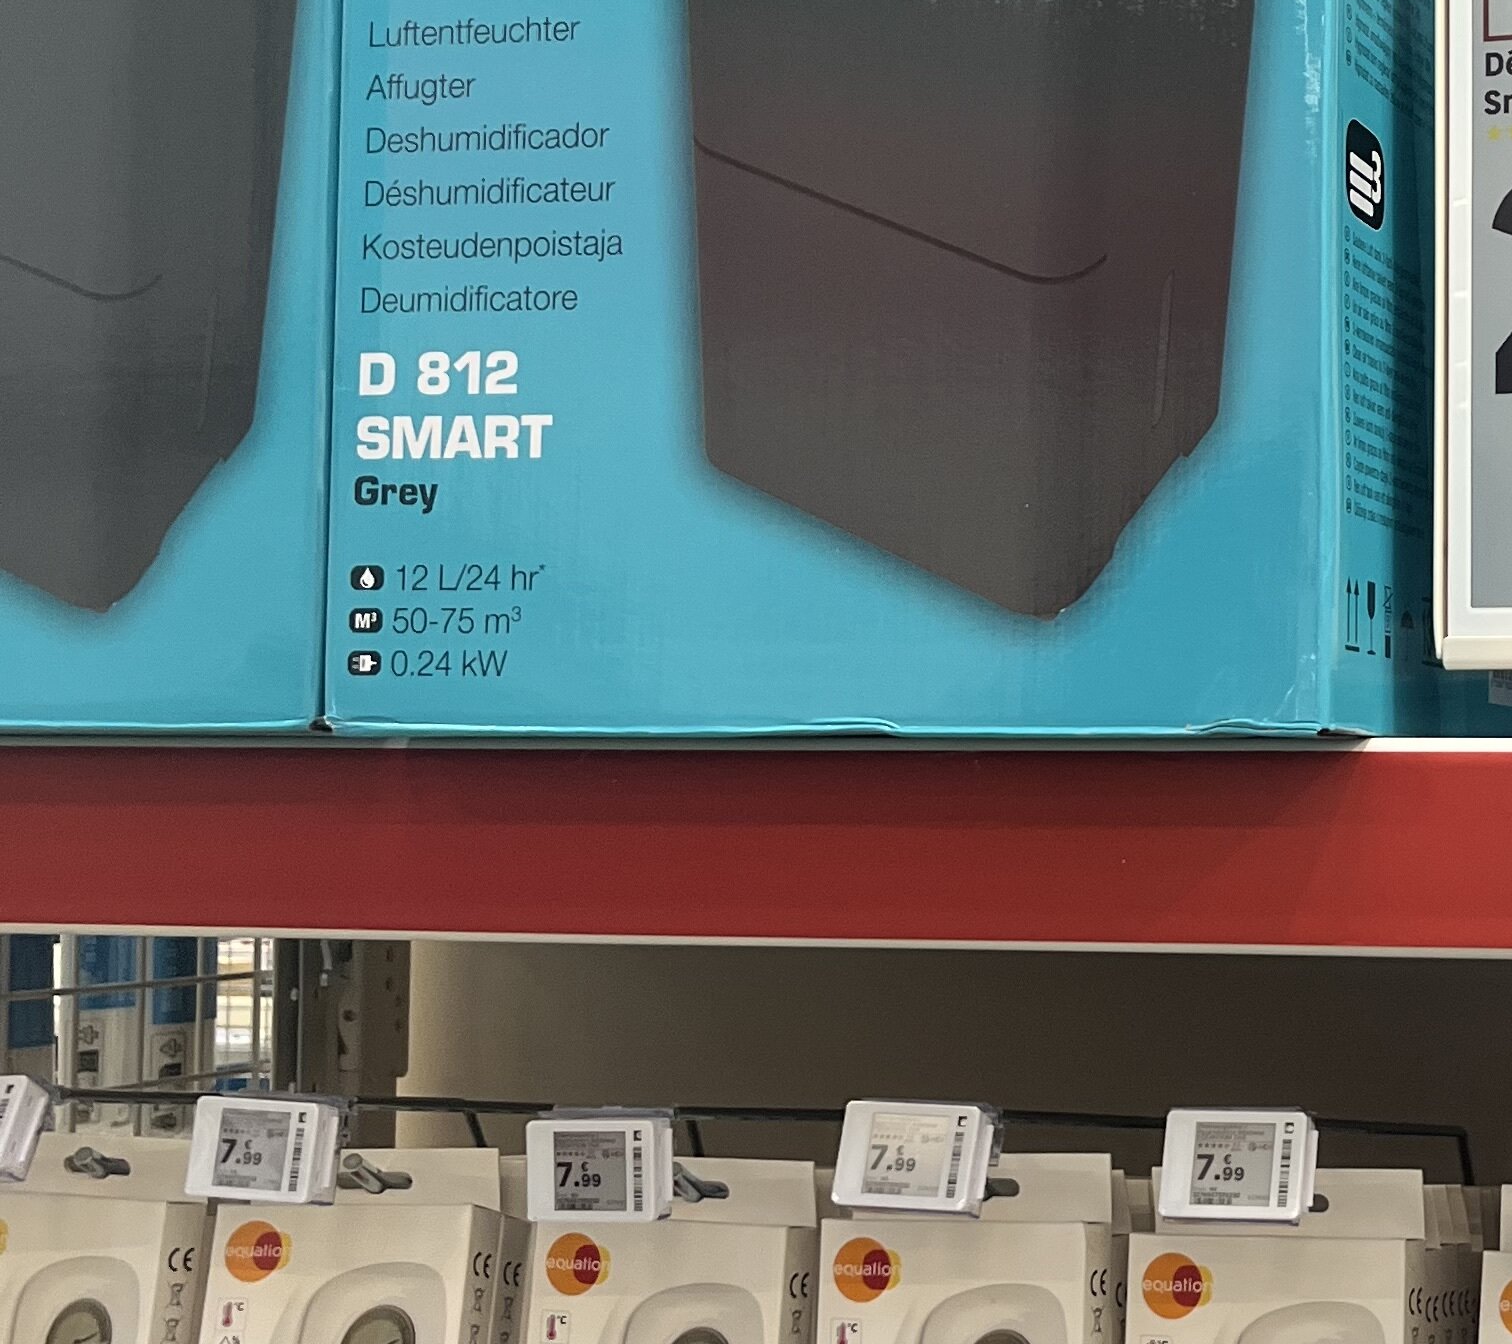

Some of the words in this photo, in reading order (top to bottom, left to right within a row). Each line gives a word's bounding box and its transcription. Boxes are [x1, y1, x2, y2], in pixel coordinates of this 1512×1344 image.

[369, 16, 580, 47] Luftentfeuchter
[366, 74, 476, 106] Affugter
[366, 122, 610, 154] Deshumidificador
[364, 177, 616, 207] Déshumidificateur
[363, 228, 623, 264] Kosteudenpoistaja
[361, 284, 579, 314] Deumidificatore
[358, 352, 396, 396] D
[417, 350, 519, 395] 812
[356, 414, 553, 460] SMART
[354, 475, 438, 515] Grey
[397, 565, 428, 591] 12
[439, 565, 501, 592] L/24
[392, 608, 475, 634] 50-75
[484, 606, 522, 634] m³
[391, 650, 452, 677] 0.24
[462, 649, 508, 677] kW
[219, 1137, 262, 1166] 7.99
[869, 1144, 917, 1172] 7.99
[556, 1161, 601, 1188] 7.99
[1197, 1154, 1245, 1181] 7.99
